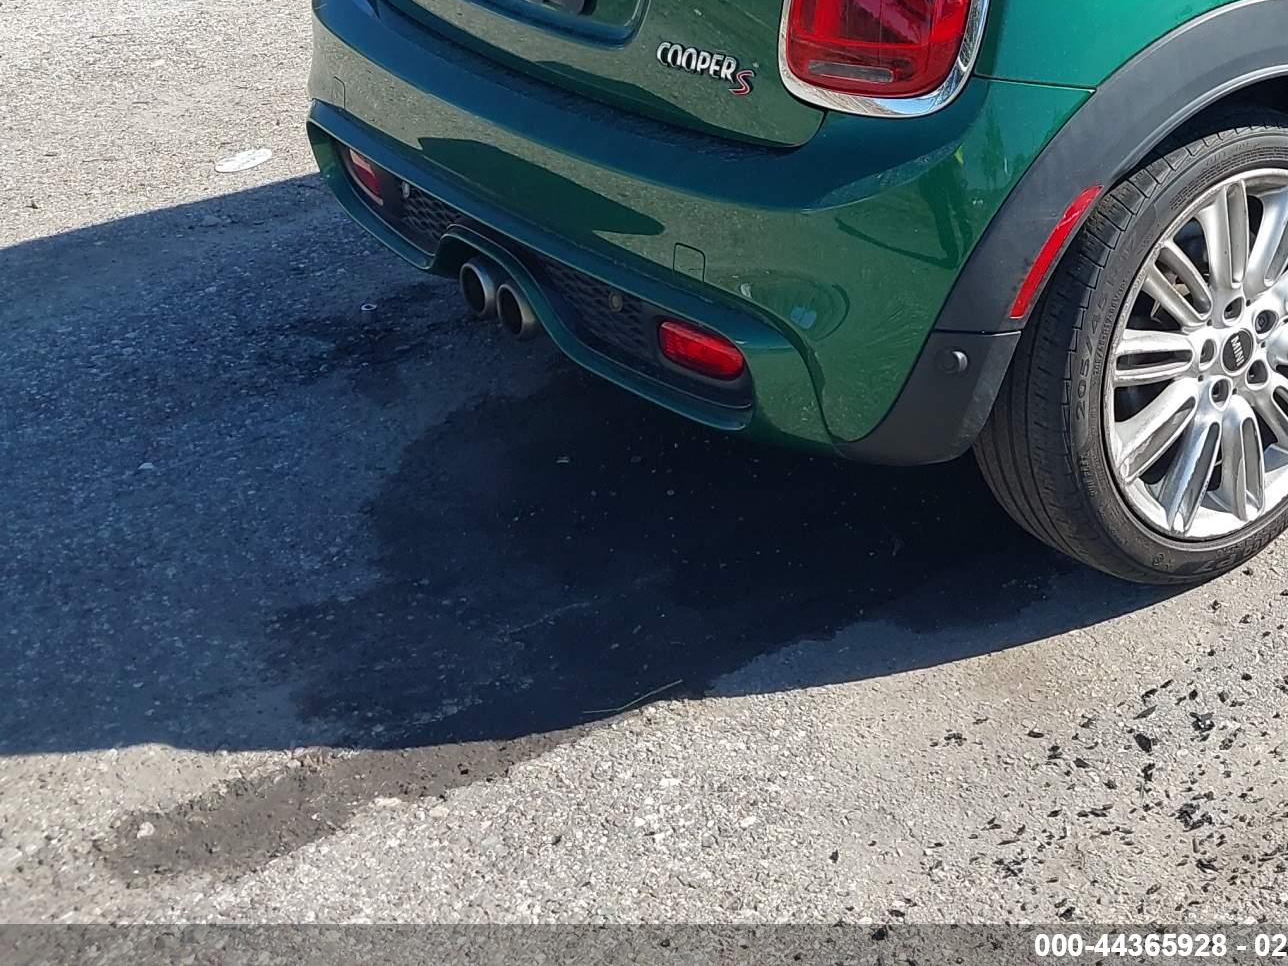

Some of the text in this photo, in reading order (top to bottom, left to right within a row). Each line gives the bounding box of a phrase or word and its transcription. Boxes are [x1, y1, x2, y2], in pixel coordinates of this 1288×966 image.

[656, 41, 755, 95] COOPER S
[1230, 335, 1245, 367] MINI
